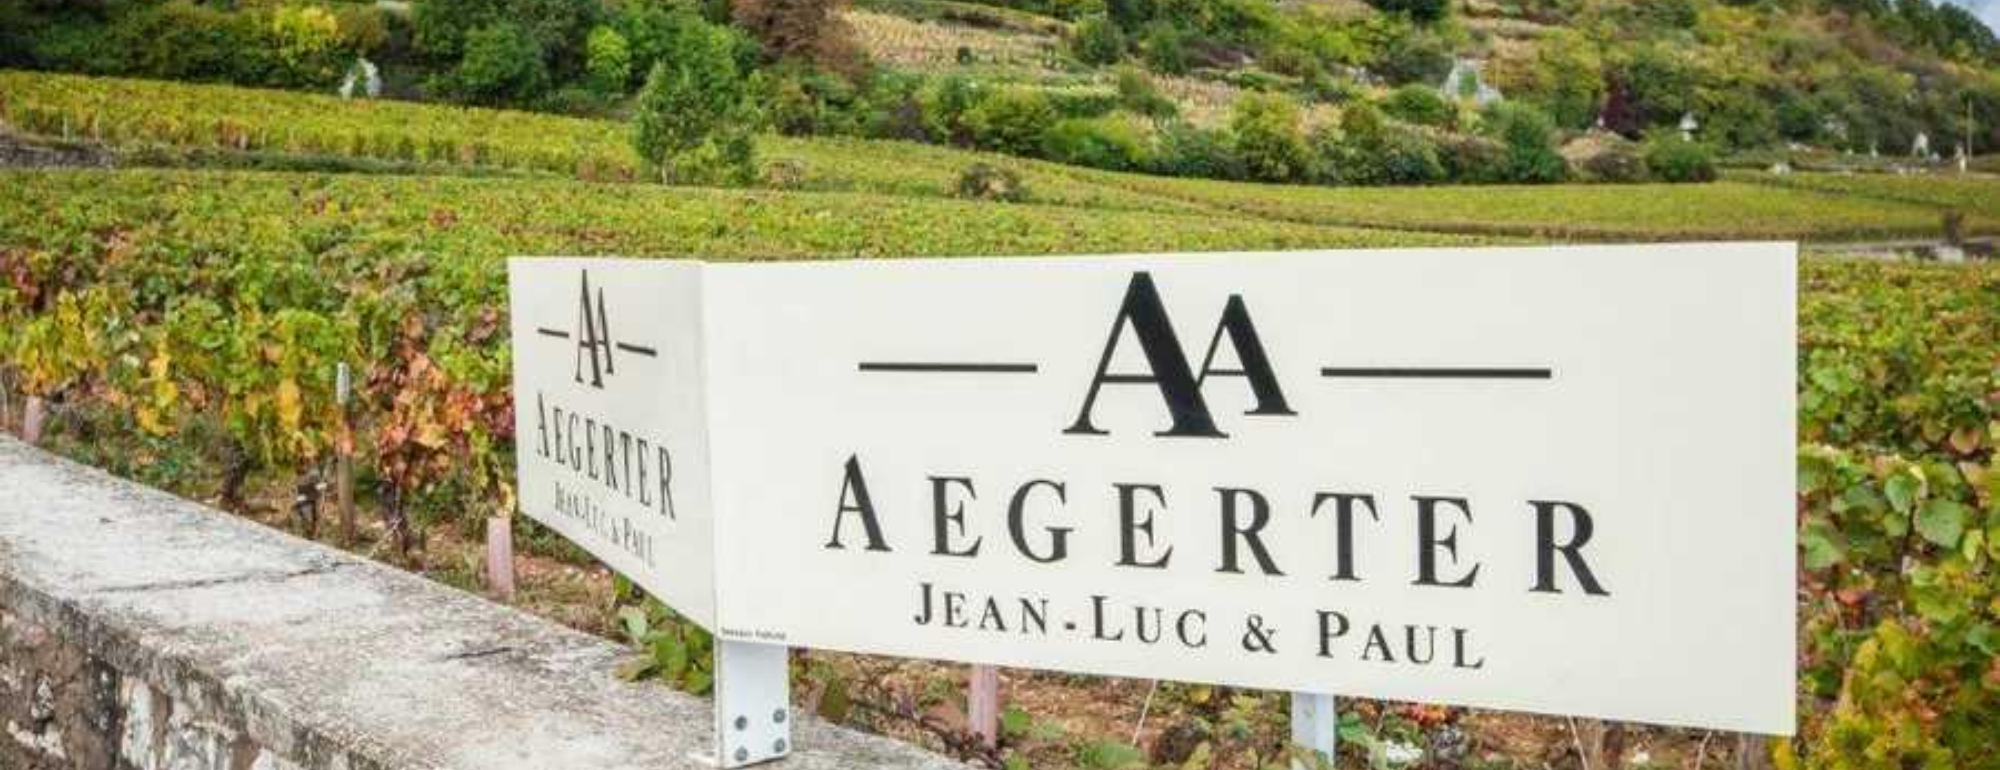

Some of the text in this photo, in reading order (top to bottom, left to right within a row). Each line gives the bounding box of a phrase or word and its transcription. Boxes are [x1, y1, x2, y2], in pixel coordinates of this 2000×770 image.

[1063, 270, 1298, 439] AA
[536, 392, 675, 520] AEGERTER
[825, 453, 1610, 597] AEGERTER
[914, 582, 1485, 669] JEAN-LUC & PAUL
